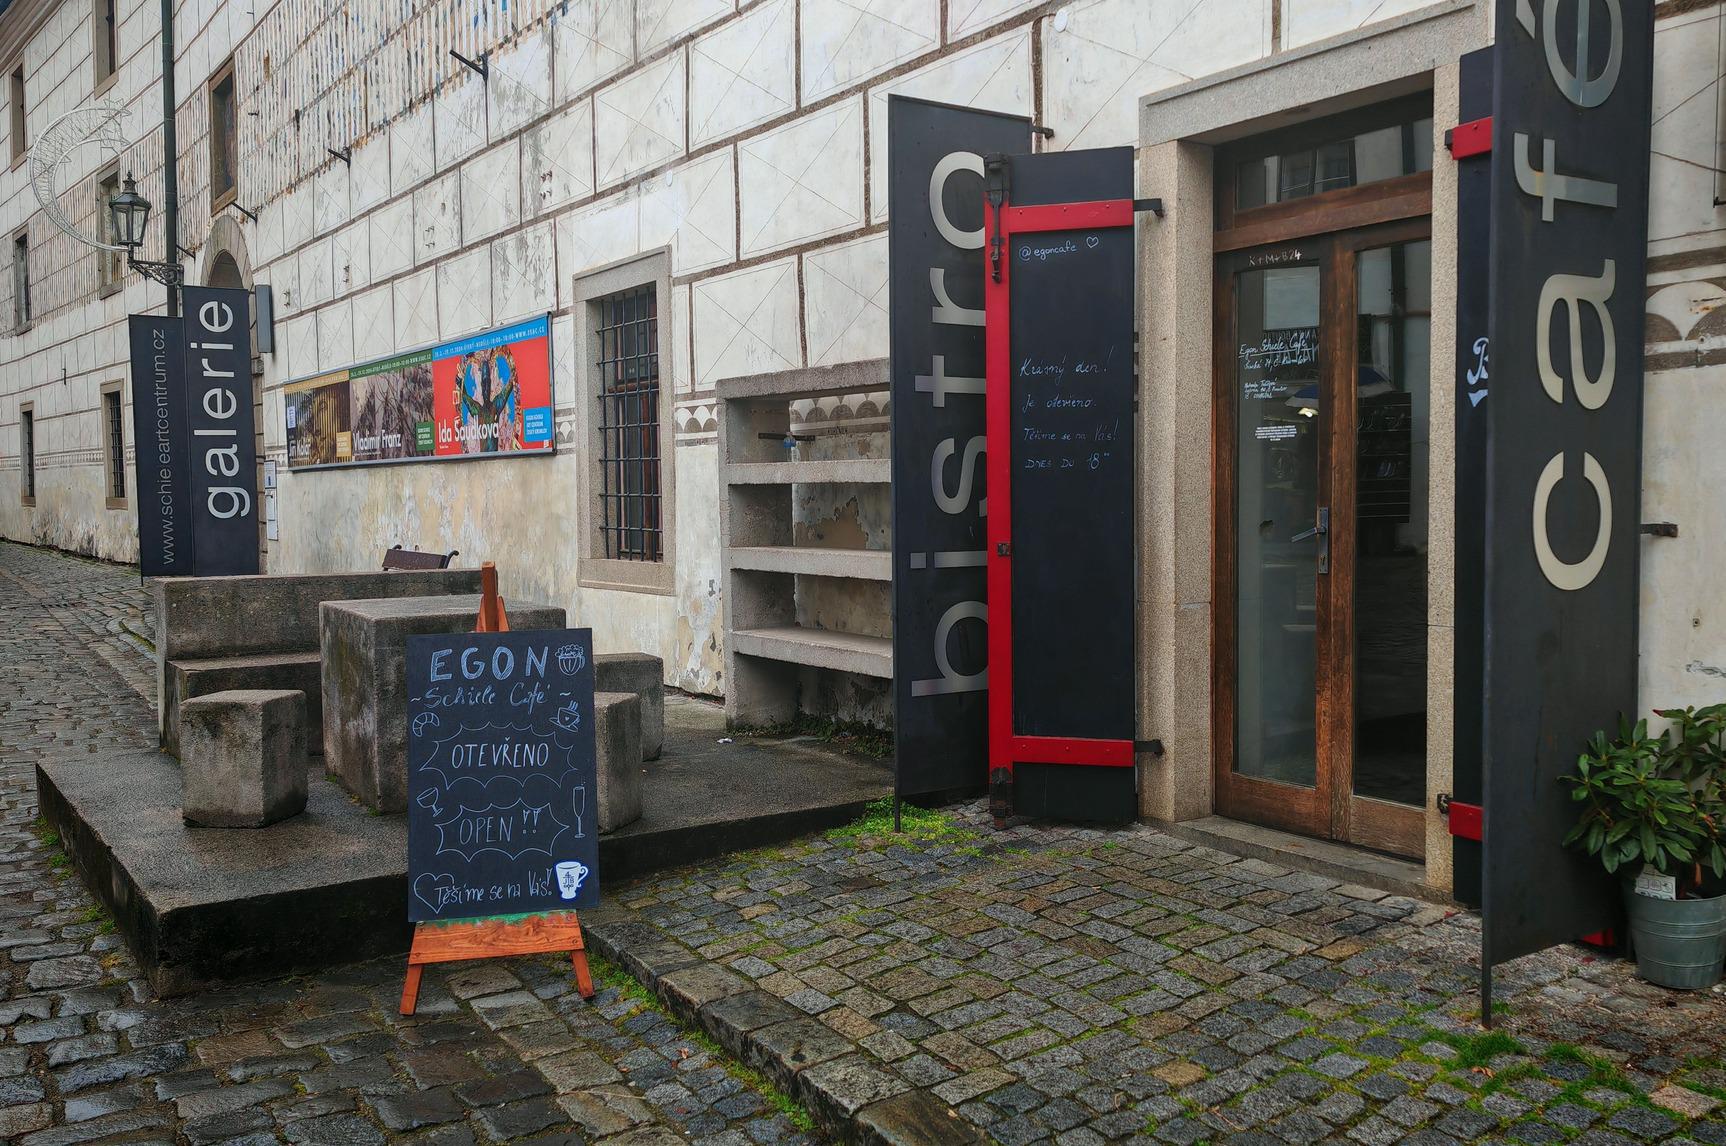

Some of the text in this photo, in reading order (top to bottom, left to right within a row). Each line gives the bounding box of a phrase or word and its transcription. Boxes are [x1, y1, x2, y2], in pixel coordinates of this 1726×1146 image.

[1513, 0, 1624, 591] café
[190, 301, 250, 519] galerie
[910, 151, 988, 697] bistro
[381, 429, 402, 449] Franz
[438, 418, 452, 443] Ida
[1061, 432, 1073, 440] se
[430, 646, 549, 682] EGON
[452, 736, 549, 768] OTEVŘENO
[459, 816, 513, 845] OPEN
[489, 885, 504, 901] se
[507, 883, 521, 898] na
